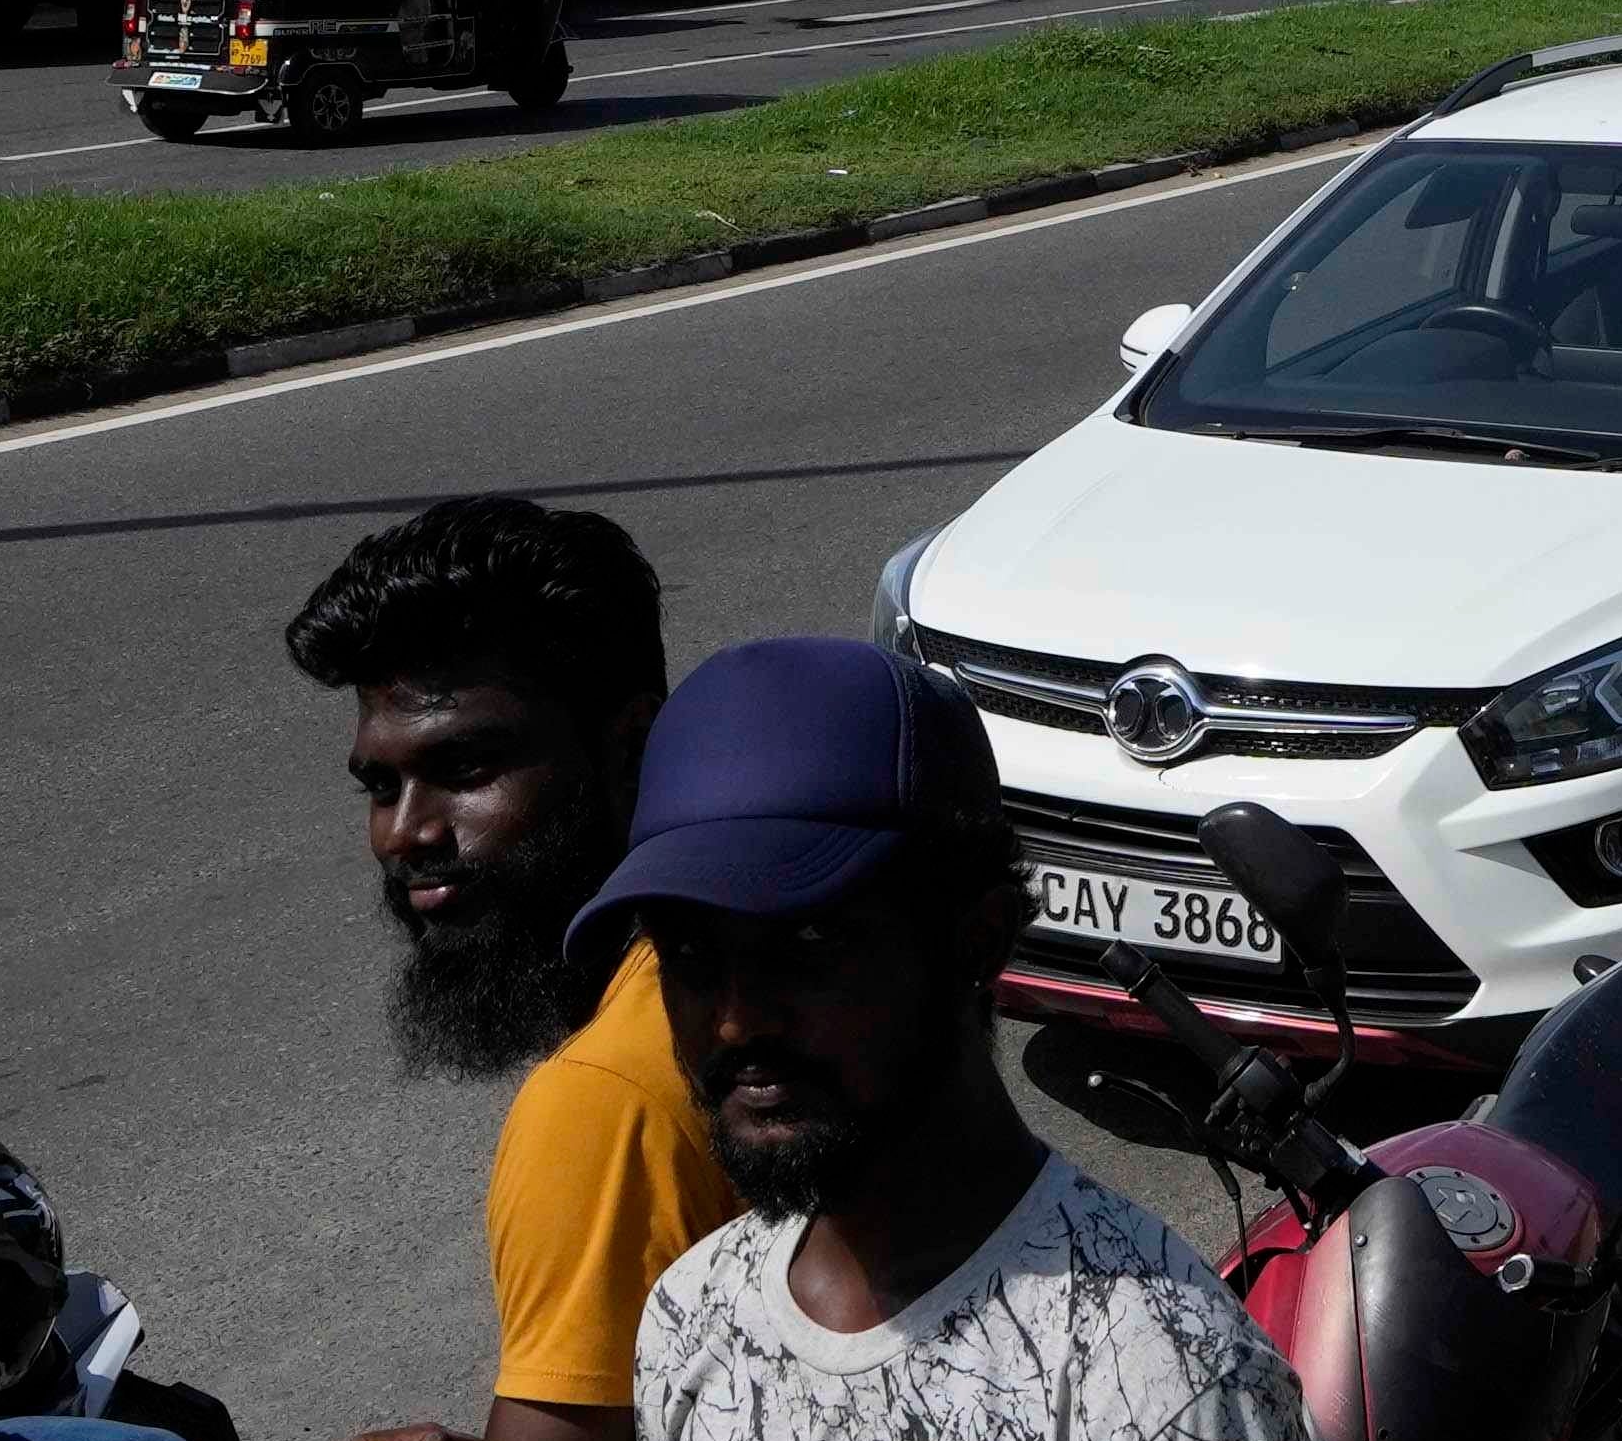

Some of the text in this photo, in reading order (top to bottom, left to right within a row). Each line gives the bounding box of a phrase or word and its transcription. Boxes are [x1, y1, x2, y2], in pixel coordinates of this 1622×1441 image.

[240, 54, 262, 64] 7769
[1041, 871, 1276, 953] CAY 3868
